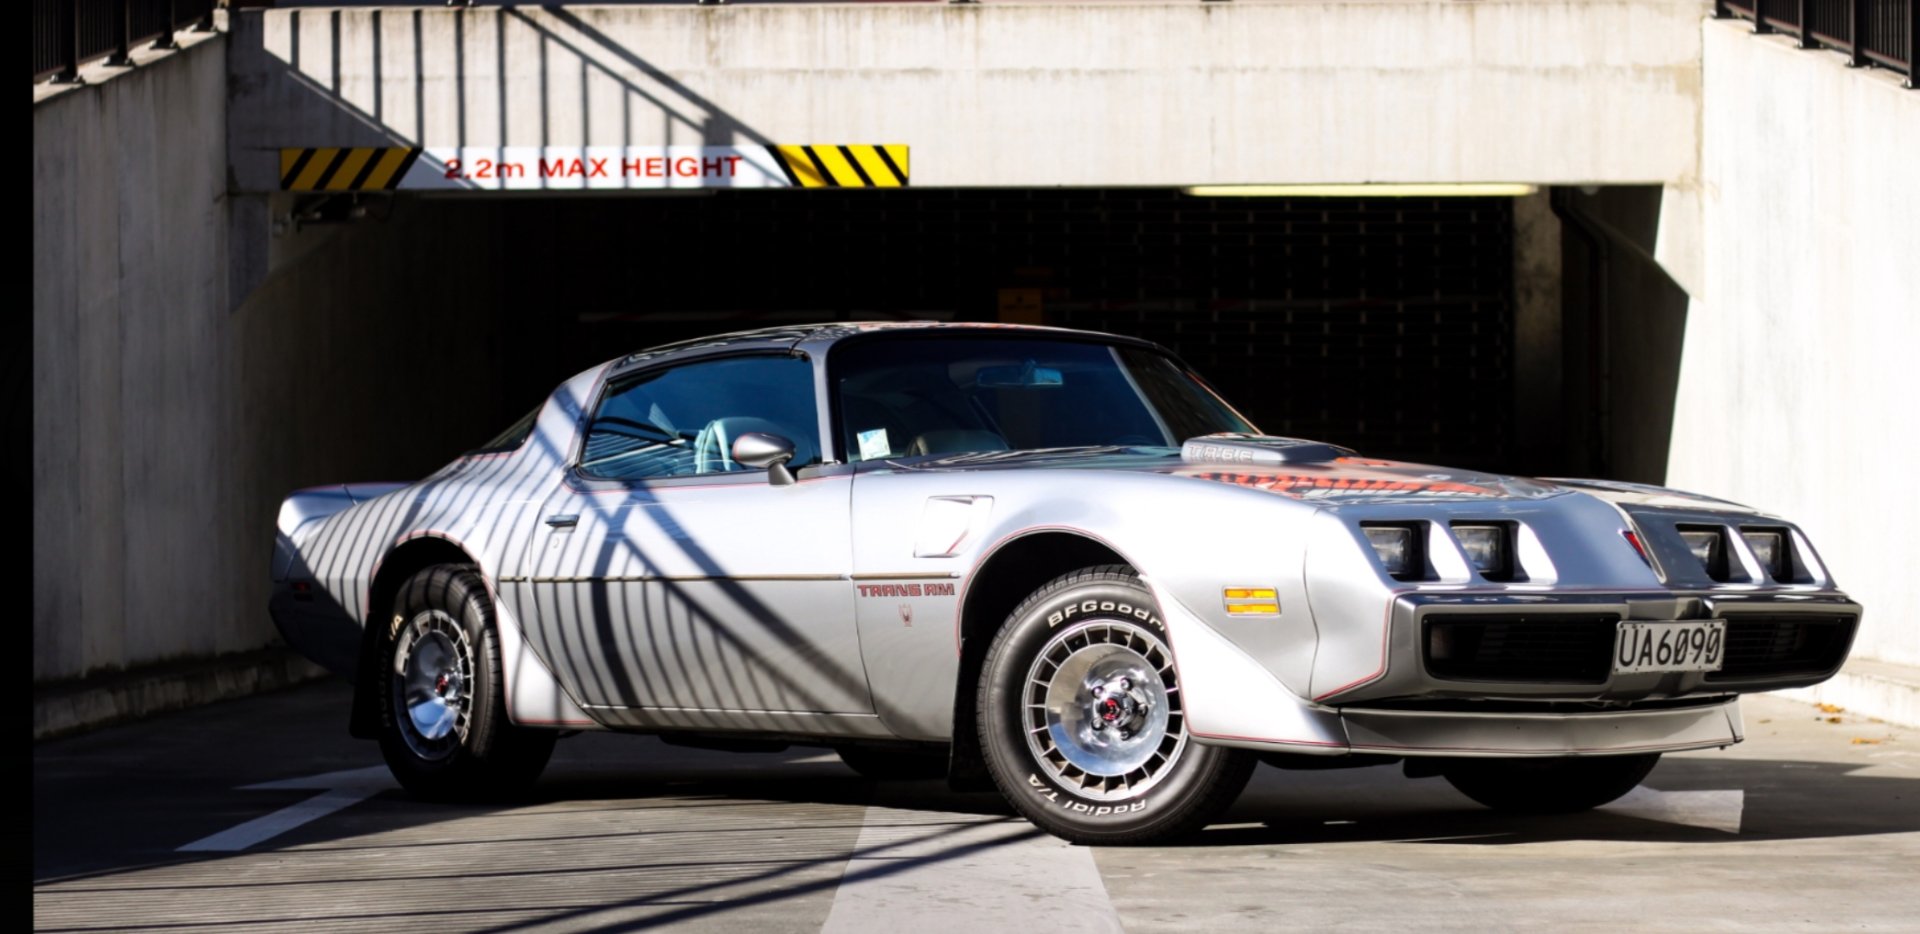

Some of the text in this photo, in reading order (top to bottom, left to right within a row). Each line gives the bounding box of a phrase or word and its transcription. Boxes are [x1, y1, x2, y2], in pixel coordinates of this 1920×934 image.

[443, 157, 743, 179] 2.2m MAX HEIGHT
[857, 583, 955, 598] TRANS AM
[1619, 627, 1722, 668] UA6090
[1028, 773, 1147, 817] Radial T/A
